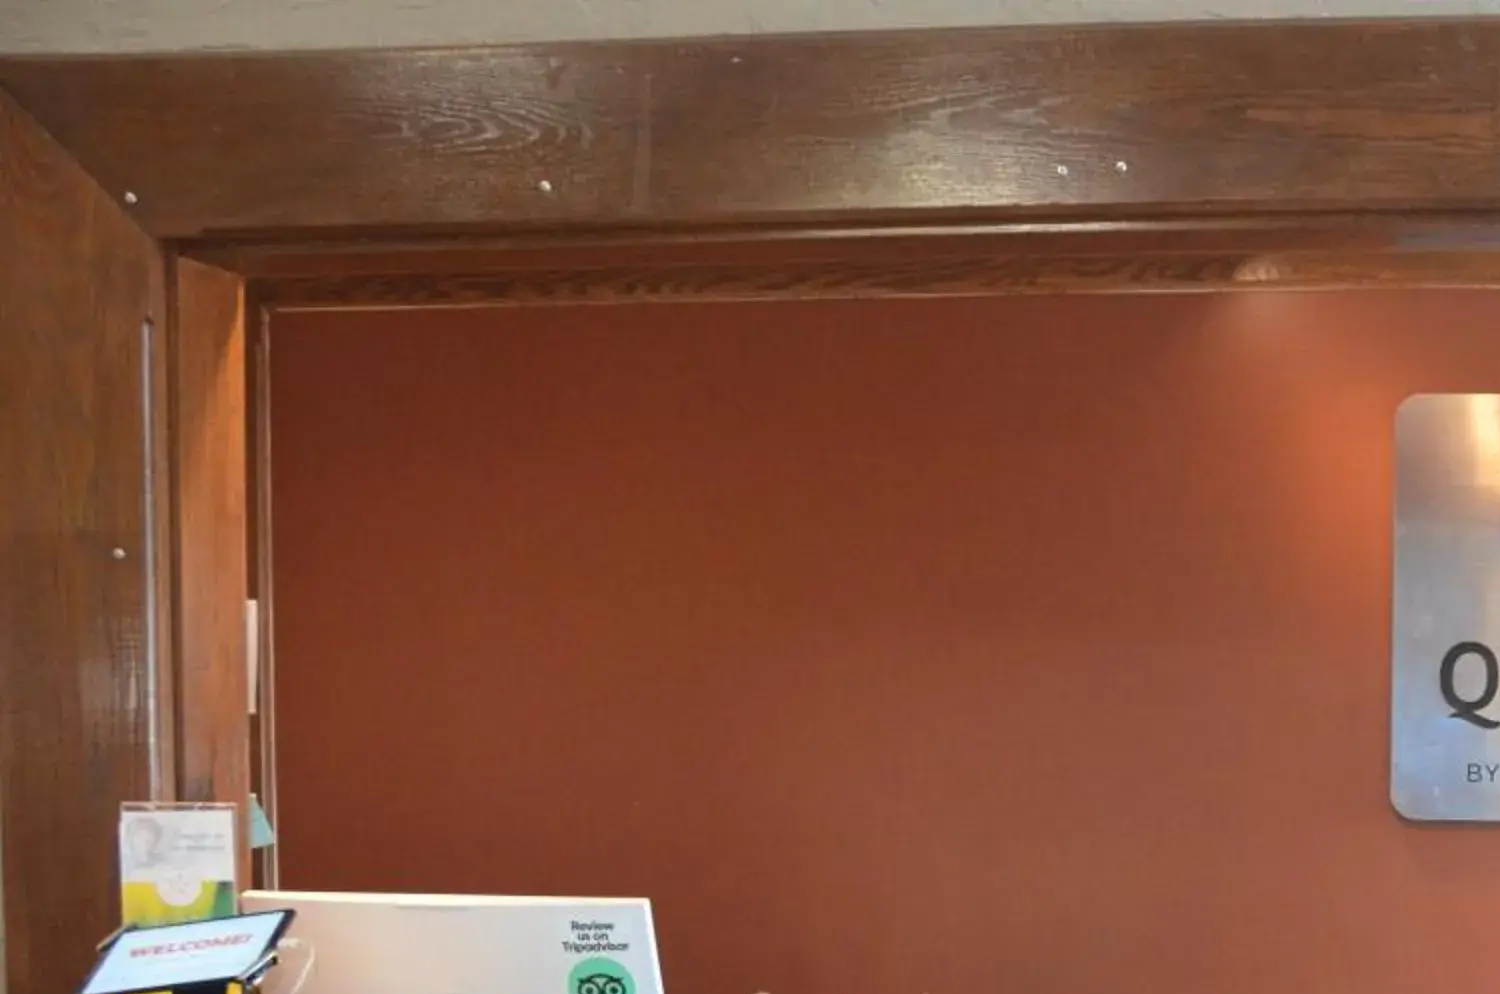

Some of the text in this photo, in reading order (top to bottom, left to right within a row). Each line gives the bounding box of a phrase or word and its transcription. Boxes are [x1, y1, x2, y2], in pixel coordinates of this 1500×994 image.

[1466, 763, 1500, 783] BY
[570, 920, 614, 931] Review
[577, 932, 609, 941] us on
[561, 941, 629, 953] Tripadvisor
